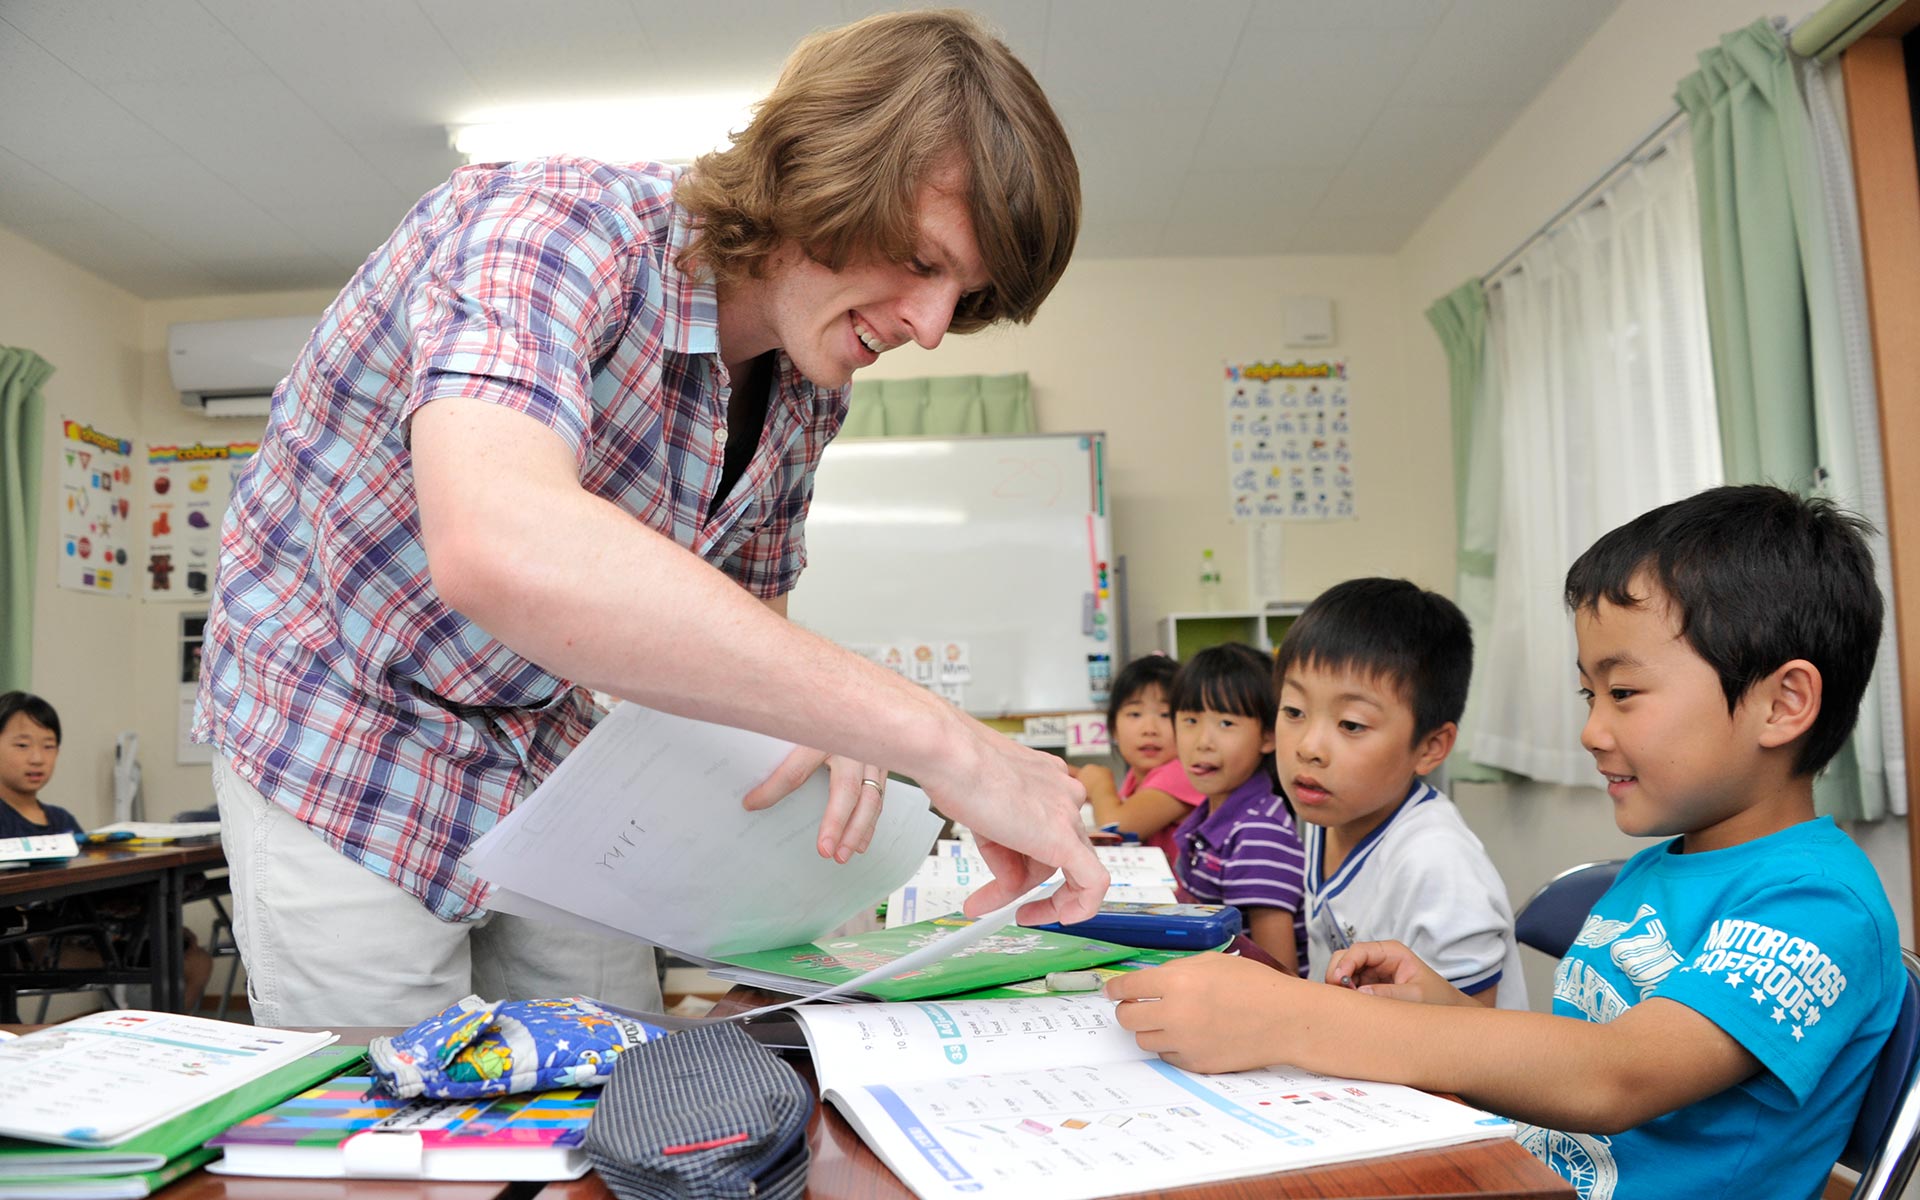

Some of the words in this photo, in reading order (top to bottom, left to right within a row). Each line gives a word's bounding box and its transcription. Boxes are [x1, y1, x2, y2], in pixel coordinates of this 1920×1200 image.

[177, 442, 230, 460] colors
[1073, 721, 1109, 745] 12
[1704, 919, 1847, 1008] MOTORCROSS
[1702, 949, 1815, 1021] OFFRODE
[950, 1045, 964, 1060] 33
